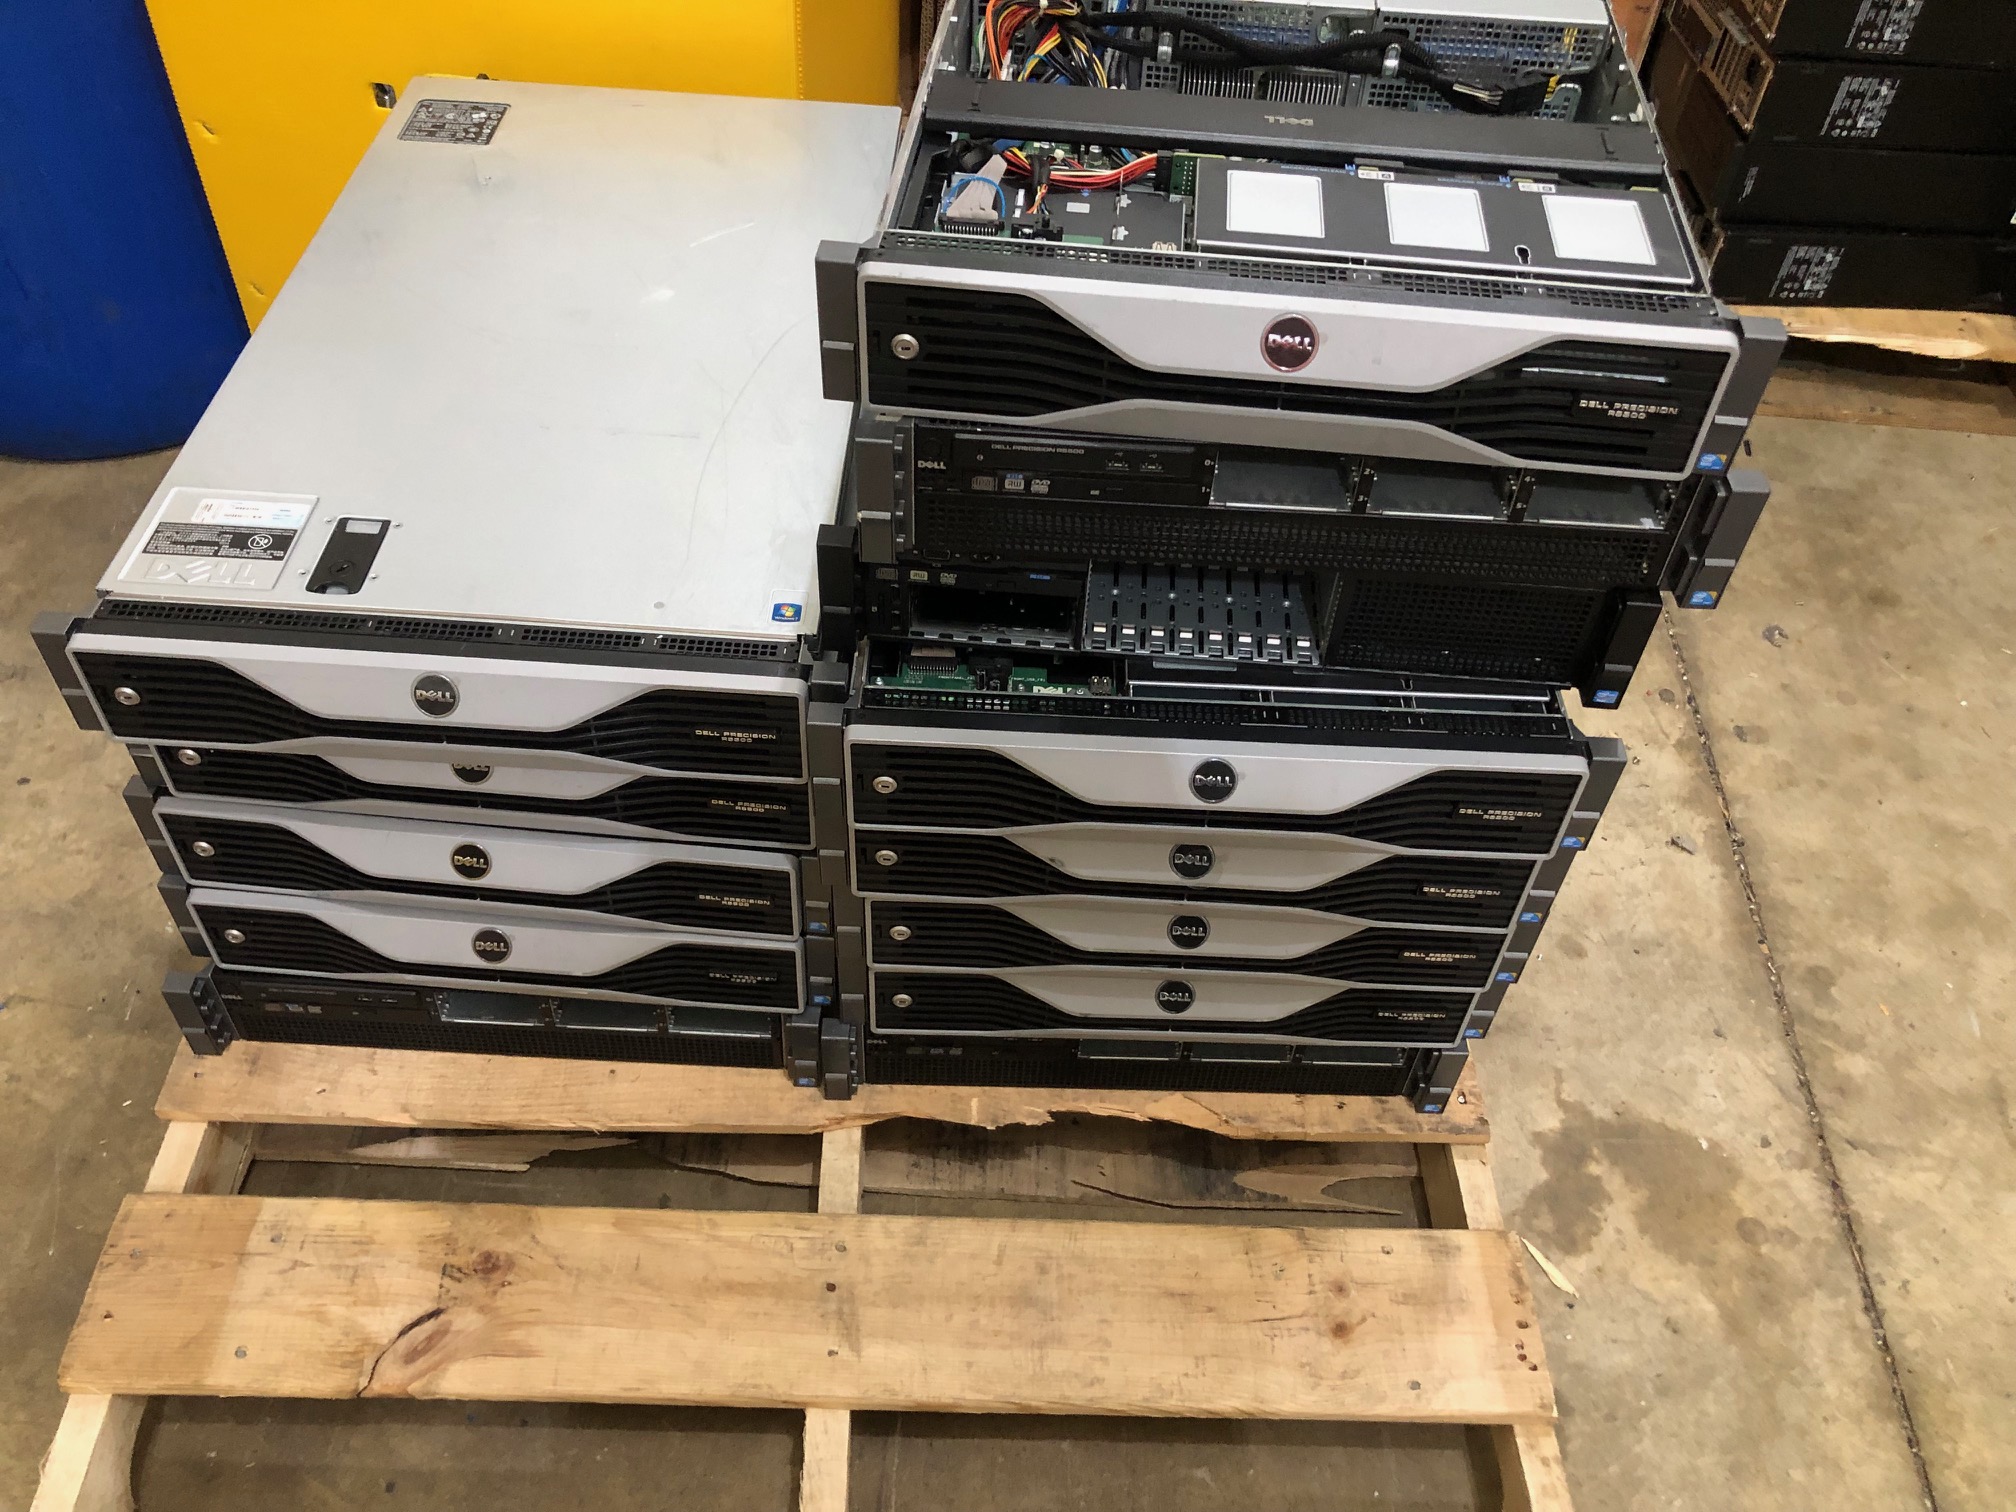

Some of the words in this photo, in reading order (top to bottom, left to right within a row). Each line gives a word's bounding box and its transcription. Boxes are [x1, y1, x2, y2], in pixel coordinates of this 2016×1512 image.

[1264, 115, 1313, 126] DELL
[1267, 333, 1312, 351] DELL
[1579, 399, 1609, 409] DELL
[1613, 402, 1679, 415] PRECISION
[917, 460, 946, 470] DELL
[415, 689, 454, 702] DELL
[695, 729, 720, 737] DELL
[723, 731, 776, 740] PRECISION
[1194, 774, 1233, 787] DELL
[454, 855, 487, 868] DELL
[1174, 853, 1209, 866] DELL
[1172, 925, 1205, 936] DELL
[475, 941, 508, 952] DELL
[1159, 991, 1191, 1002] DELL
